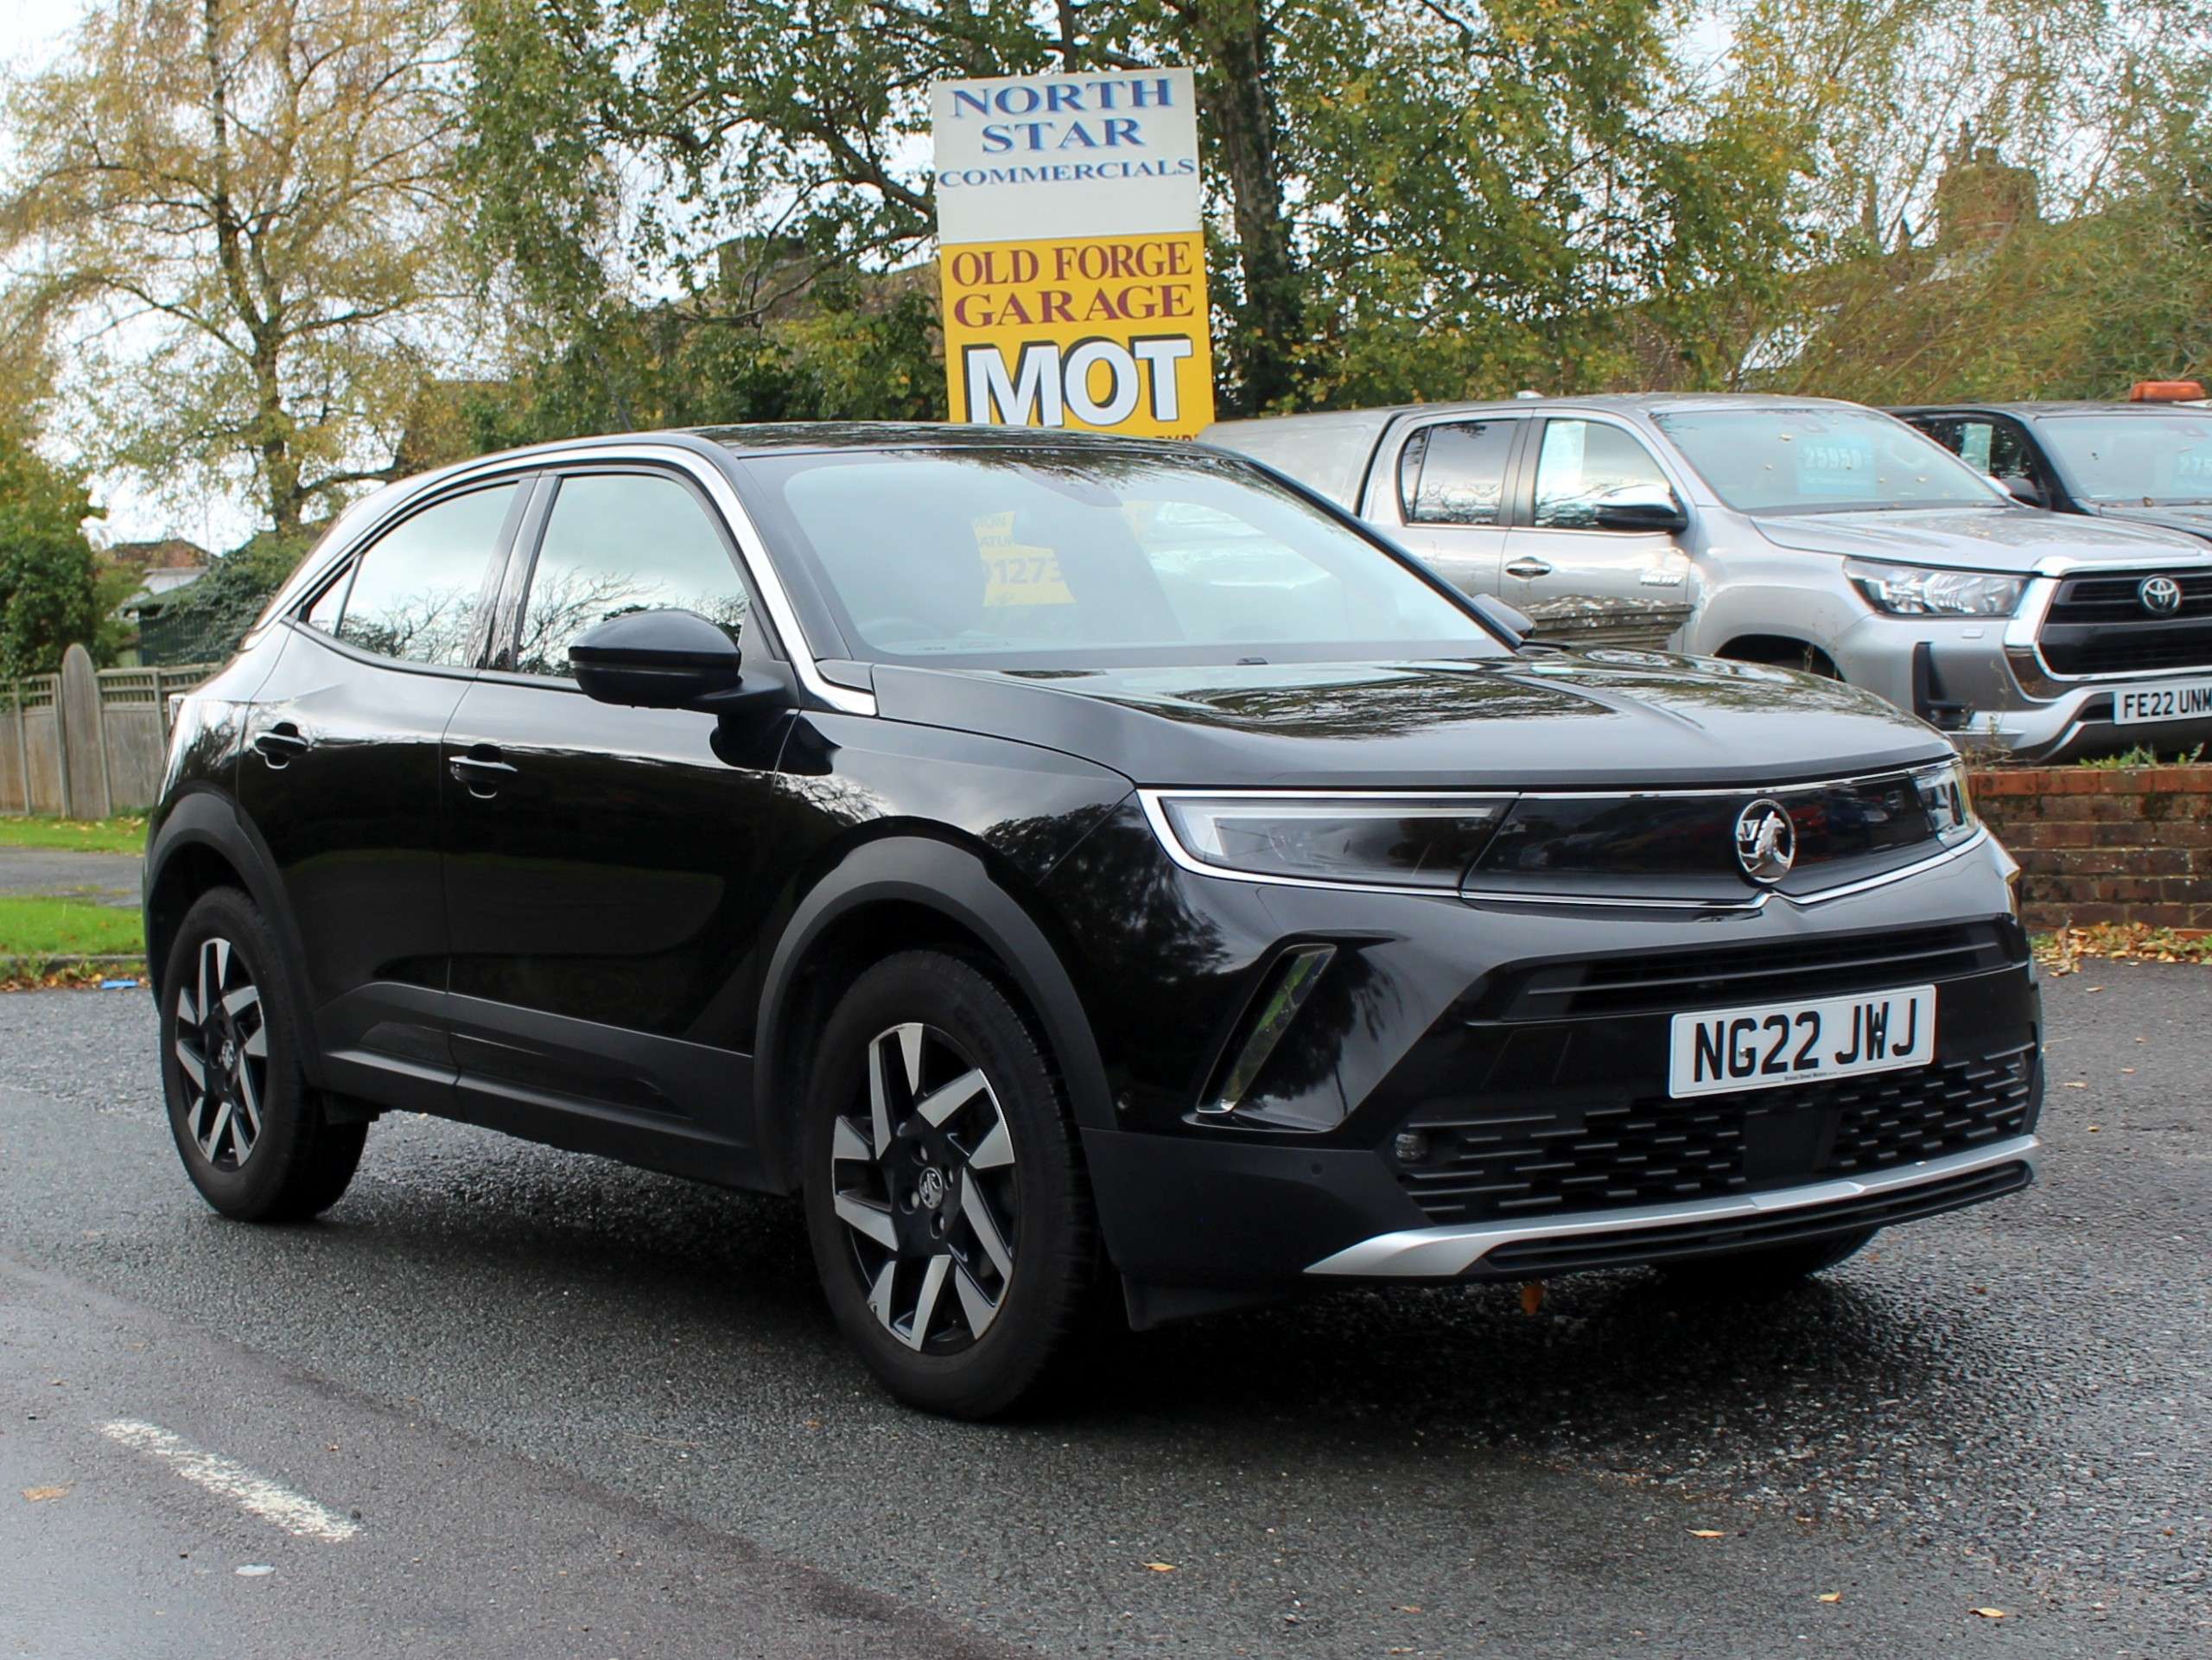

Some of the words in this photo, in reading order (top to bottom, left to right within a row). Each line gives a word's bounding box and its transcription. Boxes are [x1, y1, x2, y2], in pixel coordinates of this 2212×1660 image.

[951, 79, 1174, 118] NORTH
[982, 118, 1147, 154] STAR
[938, 158, 1196, 188] COMMERCIALS
[951, 248, 1039, 287] OLD
[1052, 241, 1193, 281] FORGE
[954, 283, 1195, 328] GARAGE
[962, 334, 1193, 427] MOT
[2123, 690, 2174, 719] FE22
[2178, 687, 2212, 713] UNM
[1694, 1010, 1821, 1083] NG22
[1834, 998, 1917, 1065] JWJ
